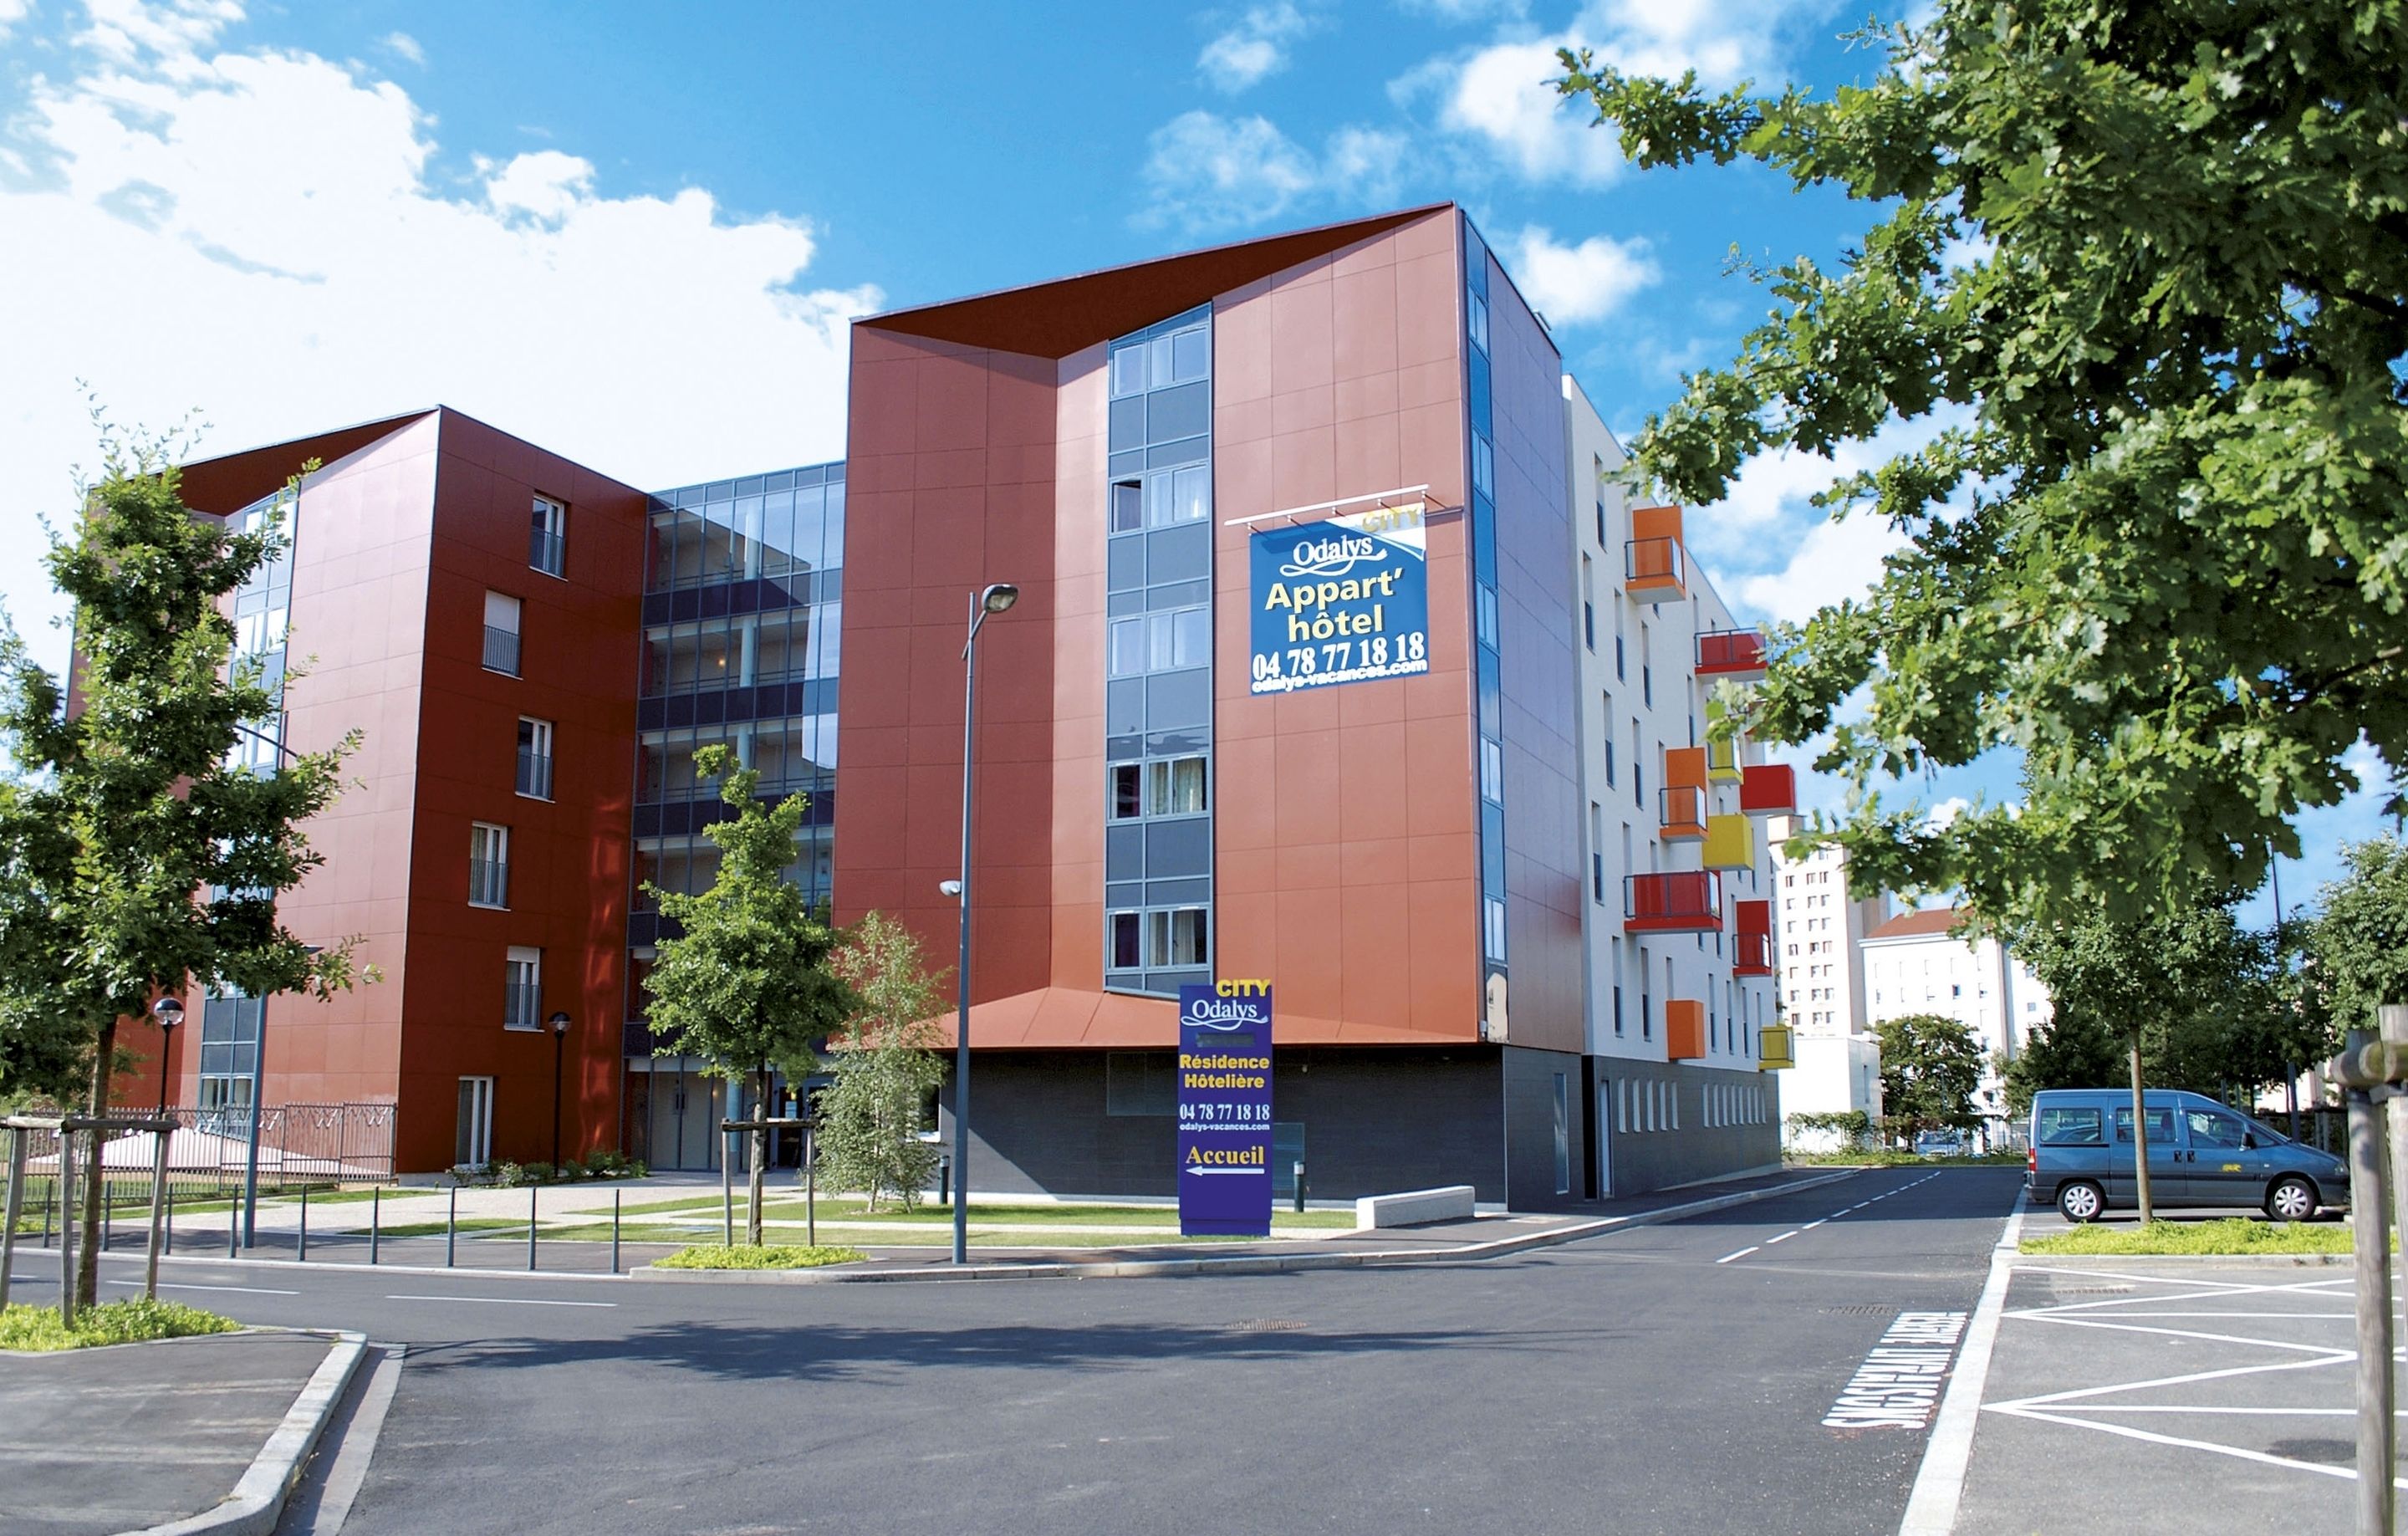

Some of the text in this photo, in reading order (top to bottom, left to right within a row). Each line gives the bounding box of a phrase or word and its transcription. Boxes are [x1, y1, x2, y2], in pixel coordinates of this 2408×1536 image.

[1361, 506, 1419, 533] CITY
[1292, 534, 1374, 572] Odalys
[1288, 604, 1384, 643] hôtel
[1252, 631, 1426, 681] 04 78 77 18 18
[1252, 659, 1428, 692] odalys-vacances.com
[1216, 978, 1271, 998] CITY
[1191, 999, 1258, 1022] Odalys
[1179, 1054, 1270, 1069] Résidence
[1184, 1073, 1265, 1089] Hôtelière
[1179, 1104, 1270, 1120] 04 78 77 18 18
[1179, 1122, 1271, 1133] odalys-vacances.com
[1185, 1146, 1265, 1165] Accueil
[1821, 1348, 1952, 1429] LIVRAISONS
